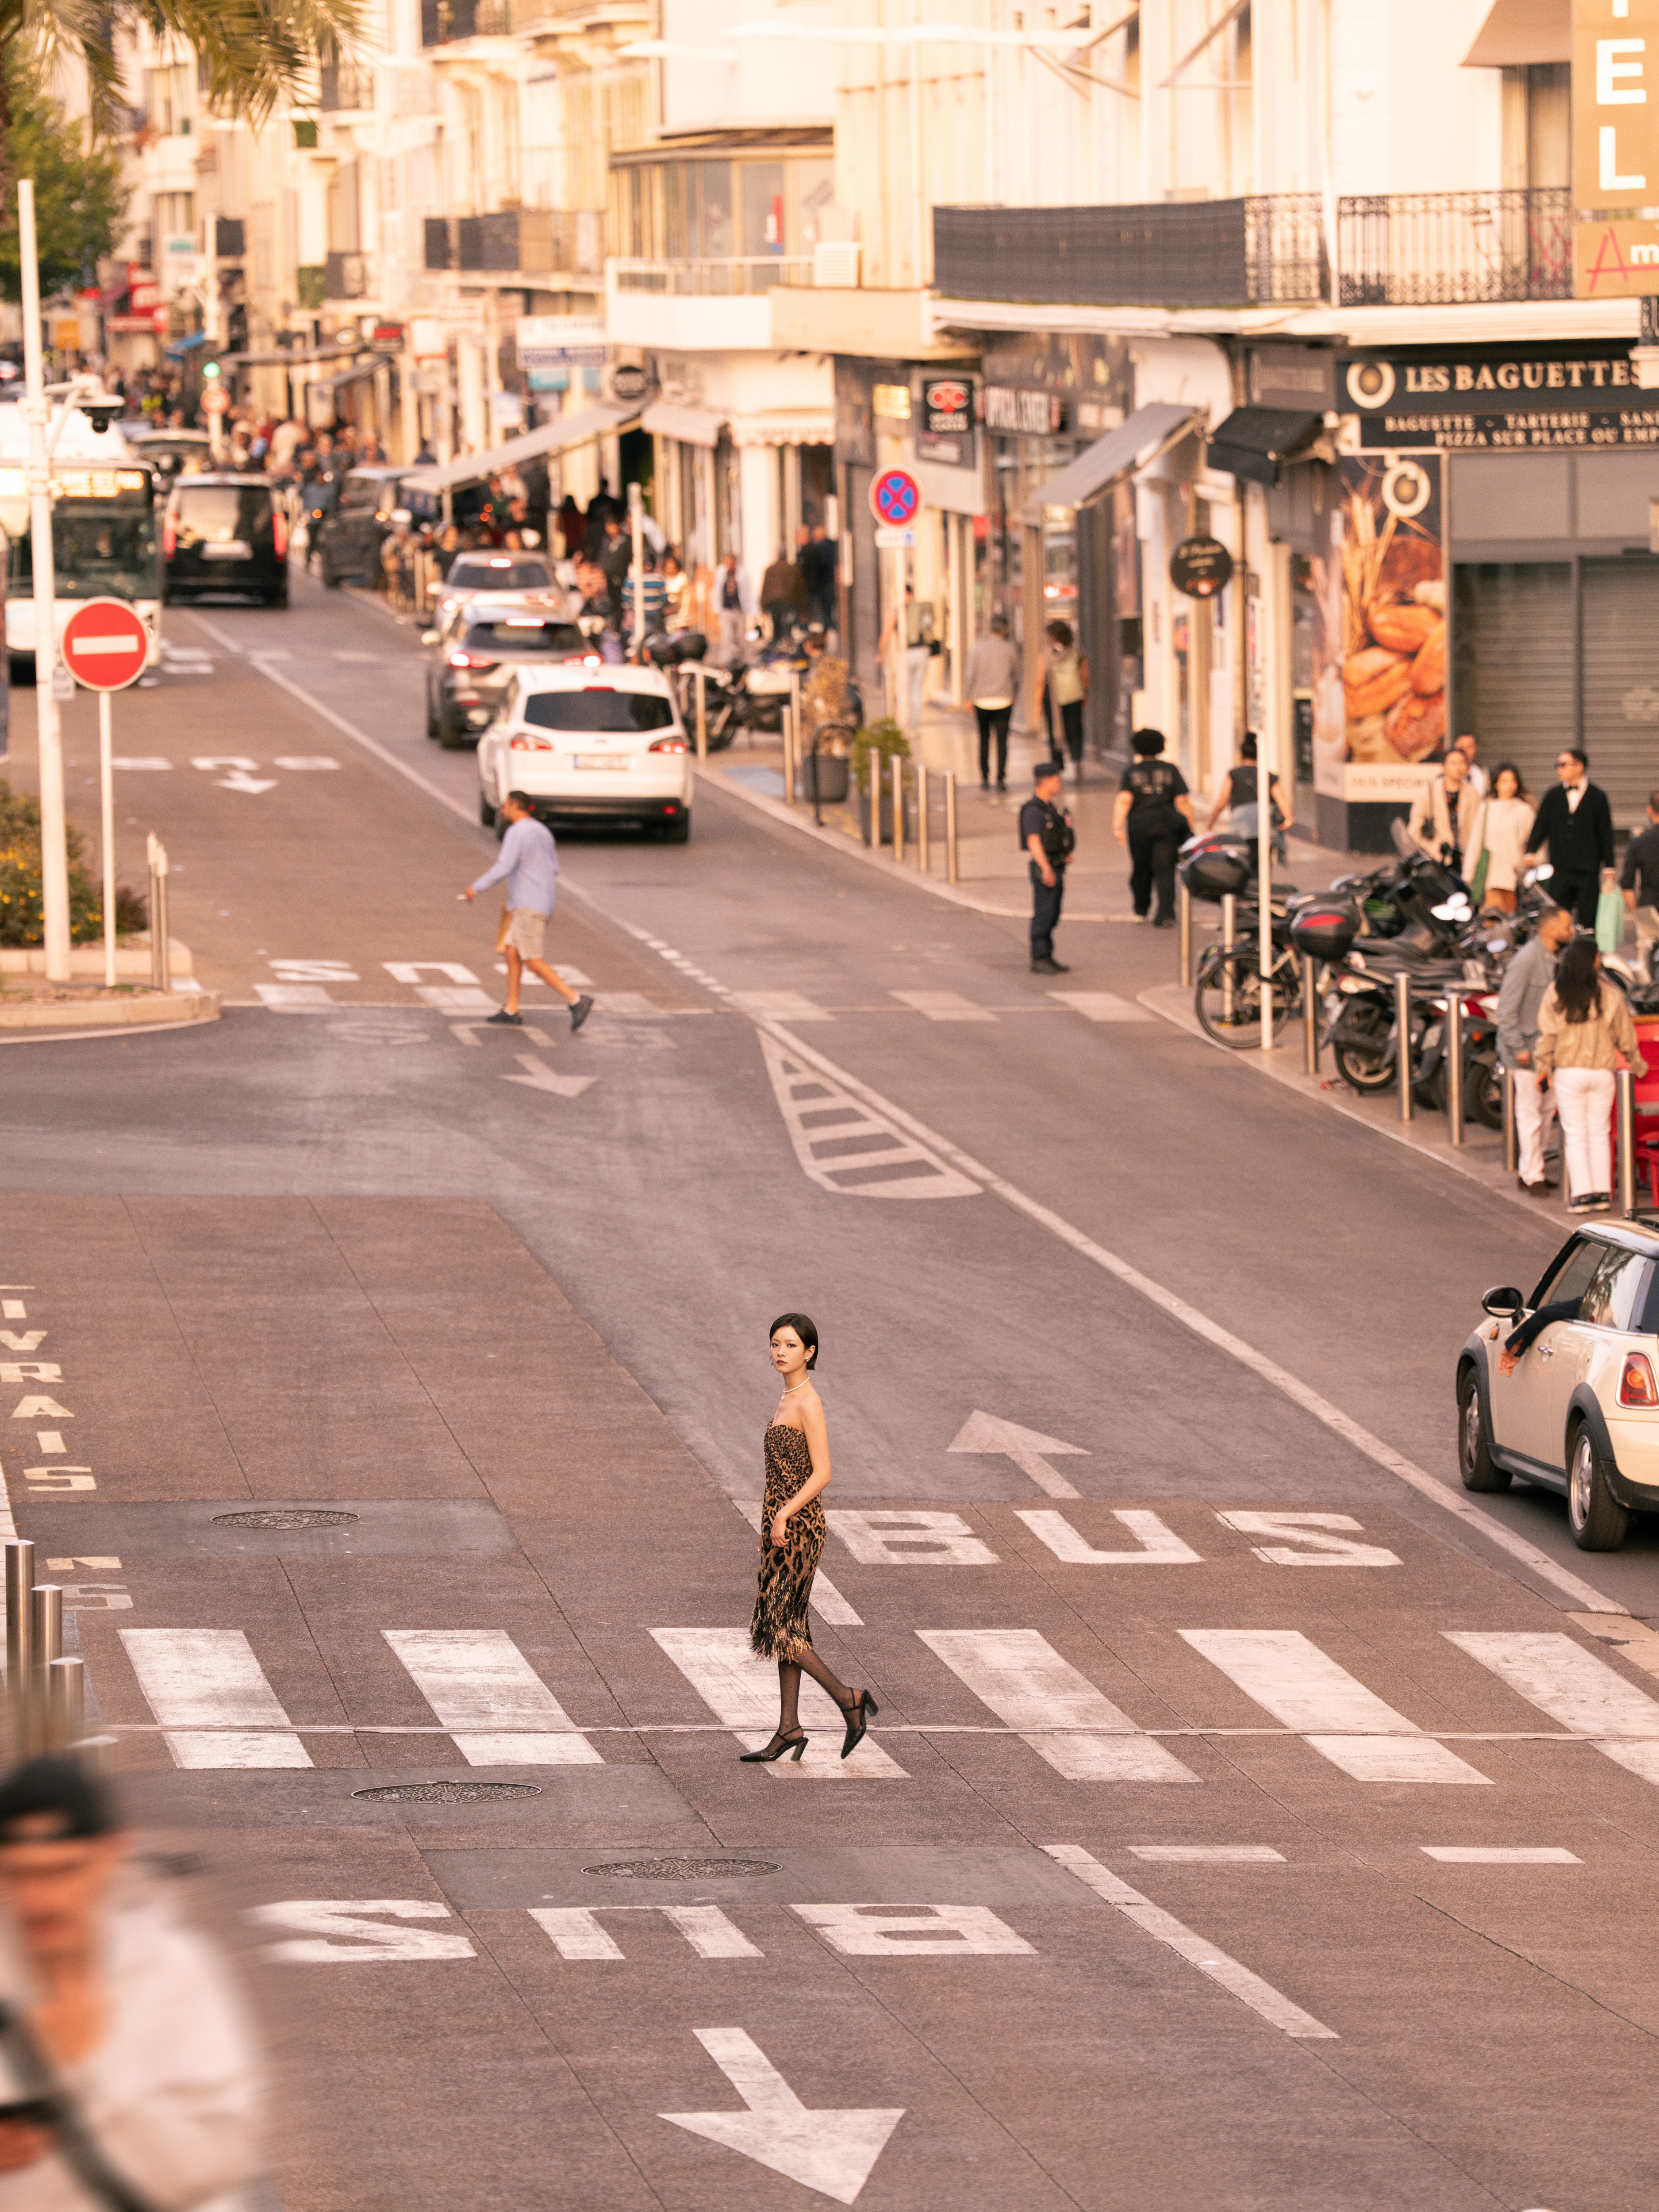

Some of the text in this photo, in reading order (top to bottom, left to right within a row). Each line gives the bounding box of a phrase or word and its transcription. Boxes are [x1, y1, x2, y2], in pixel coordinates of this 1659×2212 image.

[1596, 0, 1647, 191] EL
[1406, 366, 1450, 392] LES
[1435, 430, 1488, 447] PIZZA
[1492, 429, 1527, 445] SUR
[1531, 428, 1588, 445] PLACE
[1591, 427, 1618, 444] OU
[826, 1509, 1404, 1567] BUS
[254, 1899, 1039, 1962] BUS
